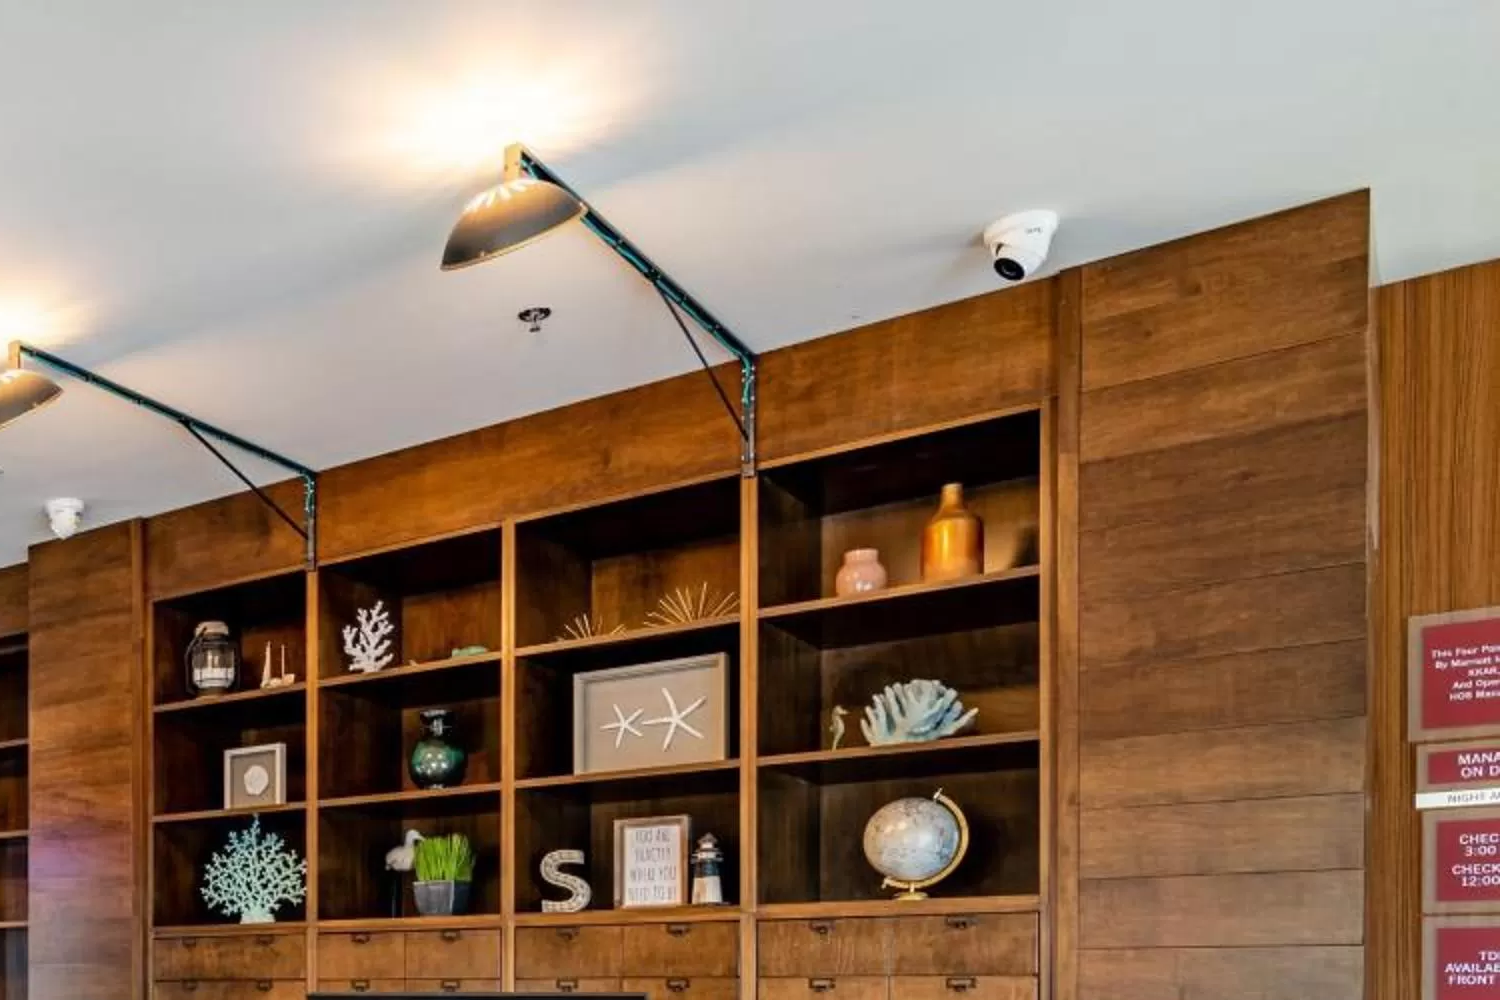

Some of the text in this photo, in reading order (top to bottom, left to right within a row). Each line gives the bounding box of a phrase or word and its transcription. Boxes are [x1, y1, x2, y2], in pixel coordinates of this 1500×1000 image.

[1452, 680, 1473, 689] And
[1461, 766, 1483, 779] ON
[1465, 845, 1497, 857] 3:00
[540, 849, 592, 912] S
[1461, 875, 1500, 887] 12:00
[1448, 974, 1494, 986] FRONT
